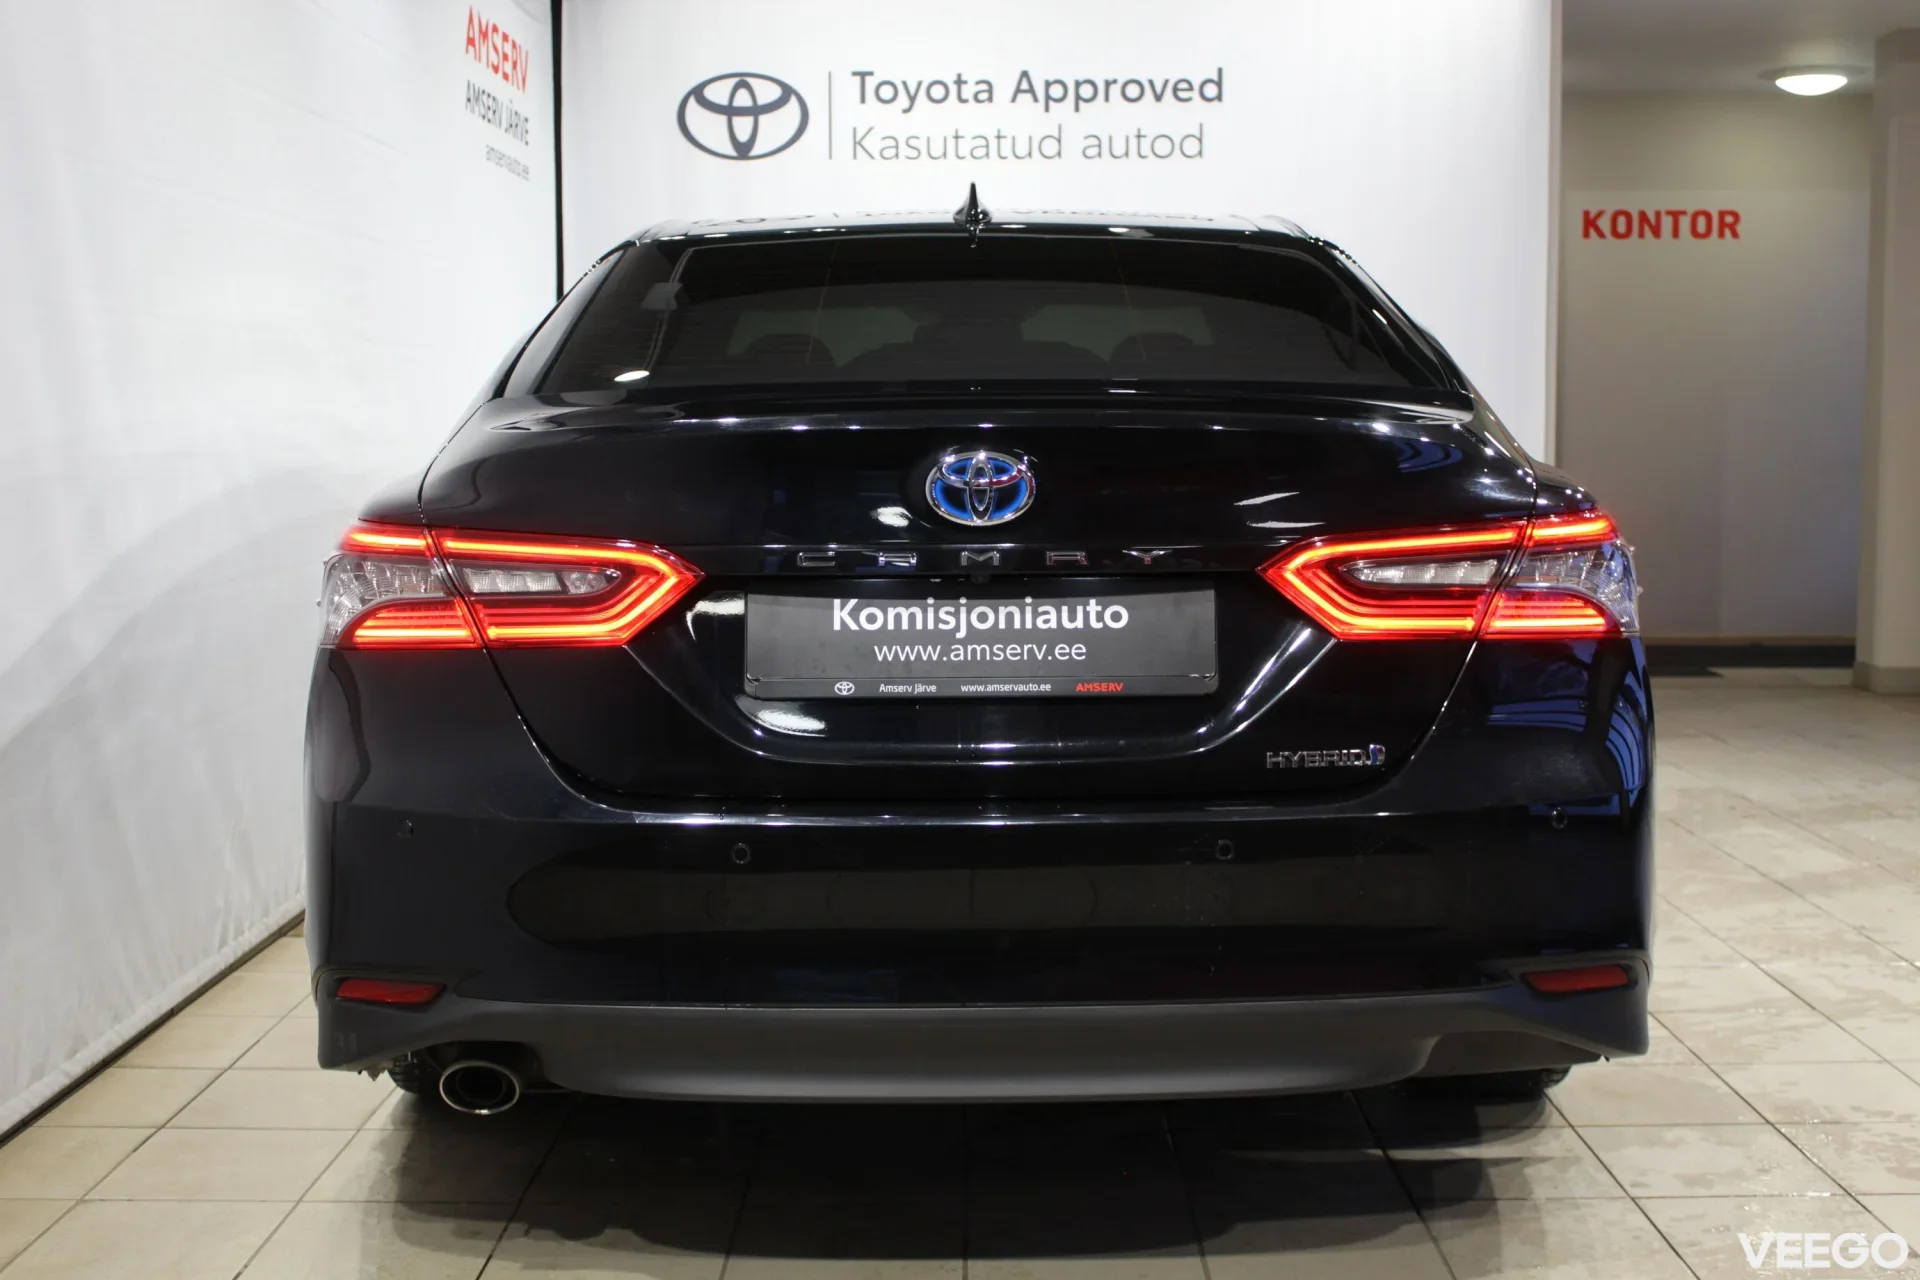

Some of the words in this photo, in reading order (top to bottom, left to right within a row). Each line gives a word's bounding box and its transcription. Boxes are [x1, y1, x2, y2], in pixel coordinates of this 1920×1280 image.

[465, 4, 529, 94] AMSERV
[851, 70, 994, 114] Toyota
[1010, 67, 1223, 113] Approved
[465, 79, 503, 130] AMSERV
[504, 99, 529, 146] JÄRVE
[852, 124, 1062, 160] Kasutatud
[1082, 123, 1204, 160] autod
[1582, 209, 1741, 240] KONTOR
[797, 549, 1172, 566] CAMRY
[832, 596, 1130, 638] Komisjoniauto
[873, 641, 1087, 662] www.amserv.ee
[879, 683, 912, 693] Amserv
[914, 683, 937, 694] Järve
[960, 682, 1051, 692] www.amservauto.ee
[1075, 682, 1124, 692] AMSERV
[1266, 749, 1367, 768] HYBRID
